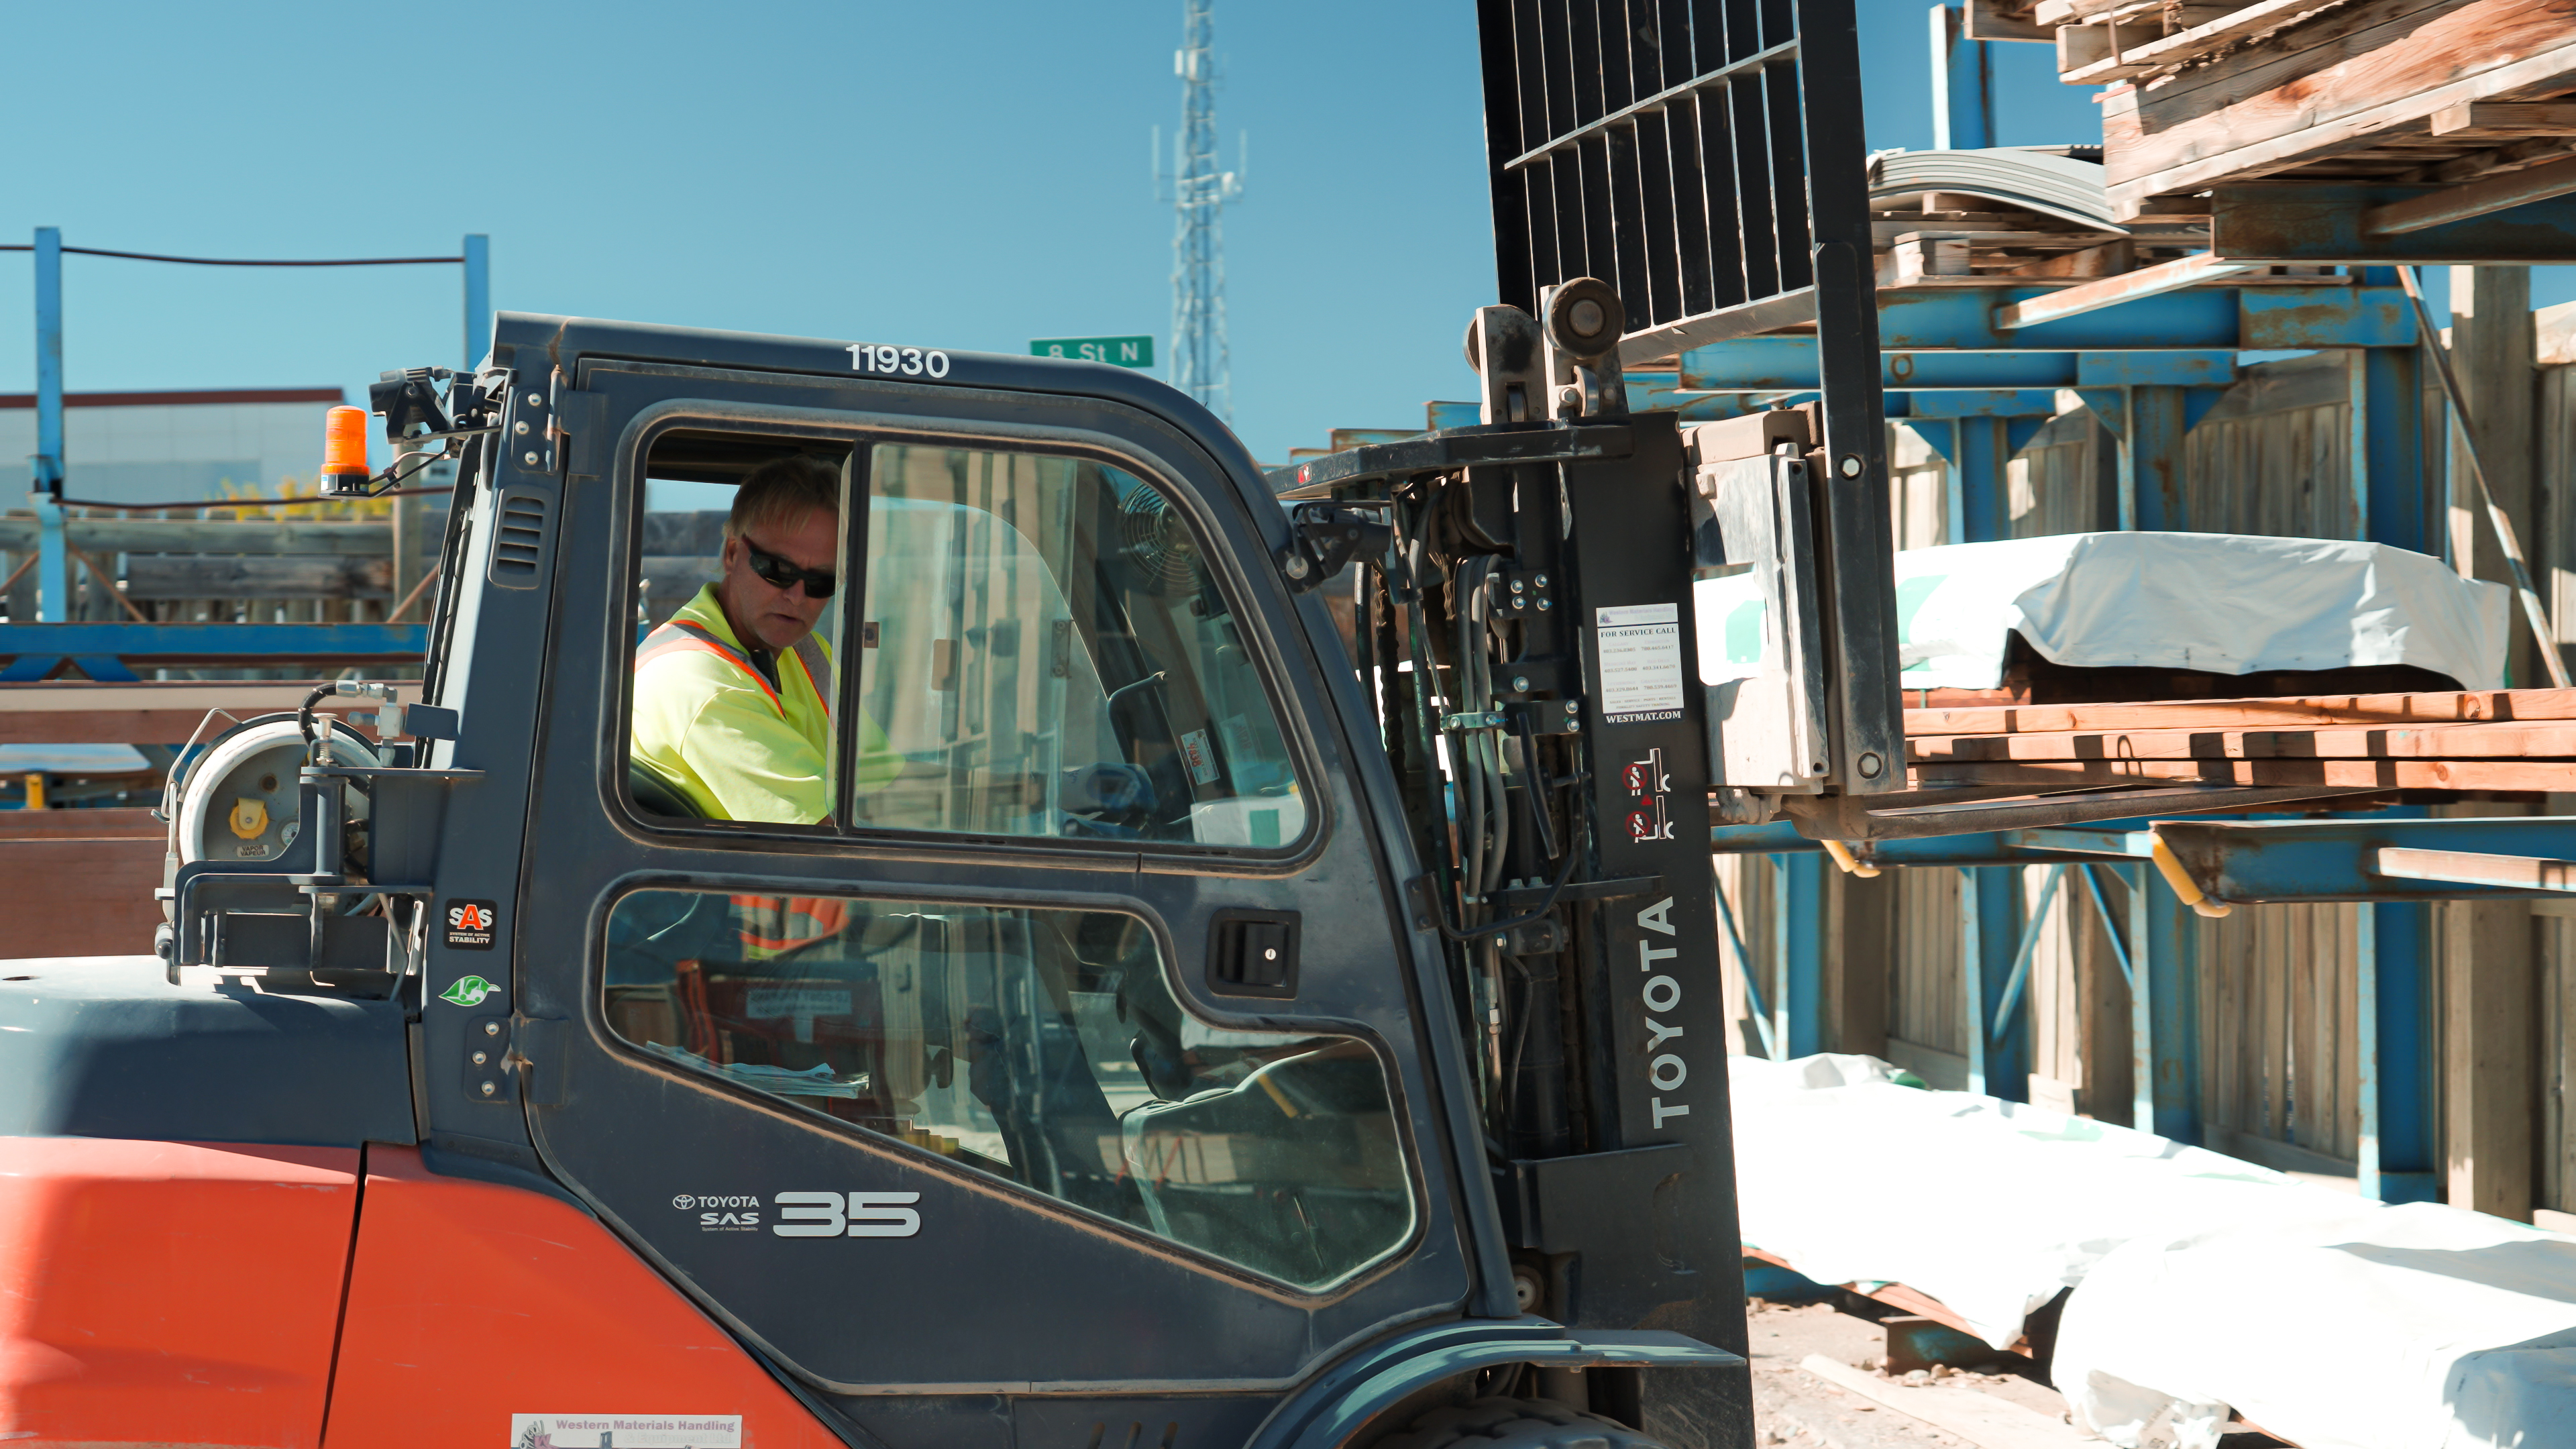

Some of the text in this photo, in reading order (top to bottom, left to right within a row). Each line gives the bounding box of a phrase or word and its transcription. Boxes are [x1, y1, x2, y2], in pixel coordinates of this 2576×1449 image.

[1049, 341, 1139, 363] 8 St N
[845, 344, 950, 378] 11930
[1619, 629, 1654, 637] SERVICE
[1605, 711, 1681, 724] WESTMAT.COM
[448, 904, 493, 930] SAS
[449, 936, 490, 944] STABILITY
[1637, 896, 1690, 1129] TOYOTA
[698, 1195, 760, 1208] TOYOTA
[700, 1212, 759, 1226] SAS
[773, 1191, 921, 1237] 35
[555, 1419, 735, 1432] Western Materials Handling
[637, 1432, 708, 1445] Equipment
